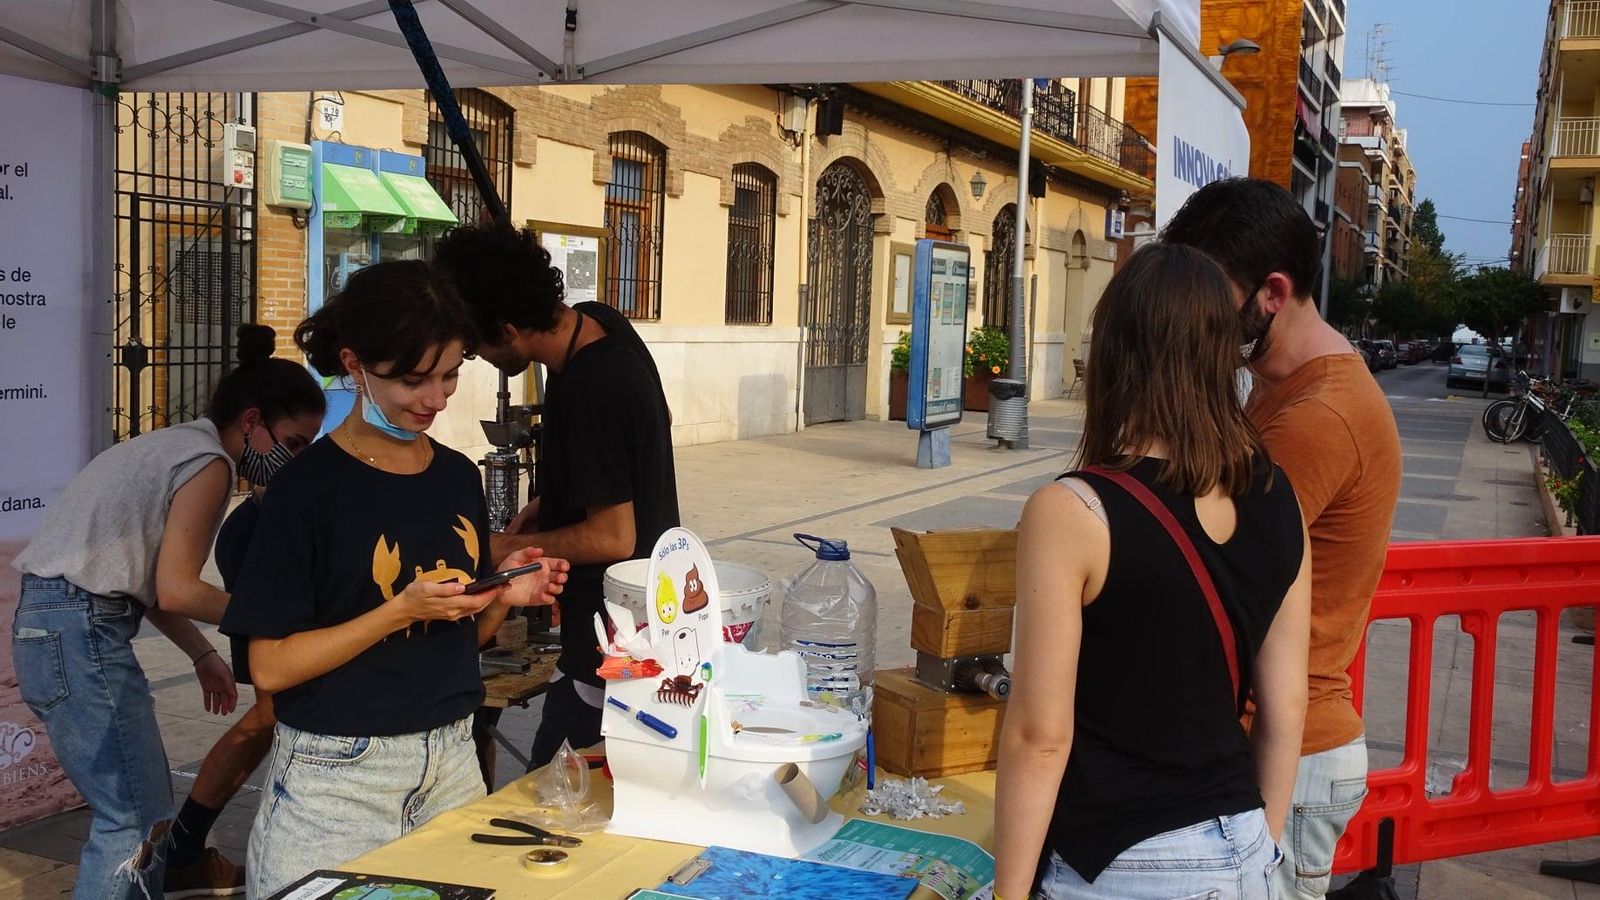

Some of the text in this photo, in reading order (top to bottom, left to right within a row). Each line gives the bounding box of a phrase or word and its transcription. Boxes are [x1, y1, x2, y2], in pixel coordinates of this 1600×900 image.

[0, 162, 28, 178] r el
[10, 267, 32, 282] de
[2, 313, 16, 329] le
[0, 496, 46, 512] dana.
